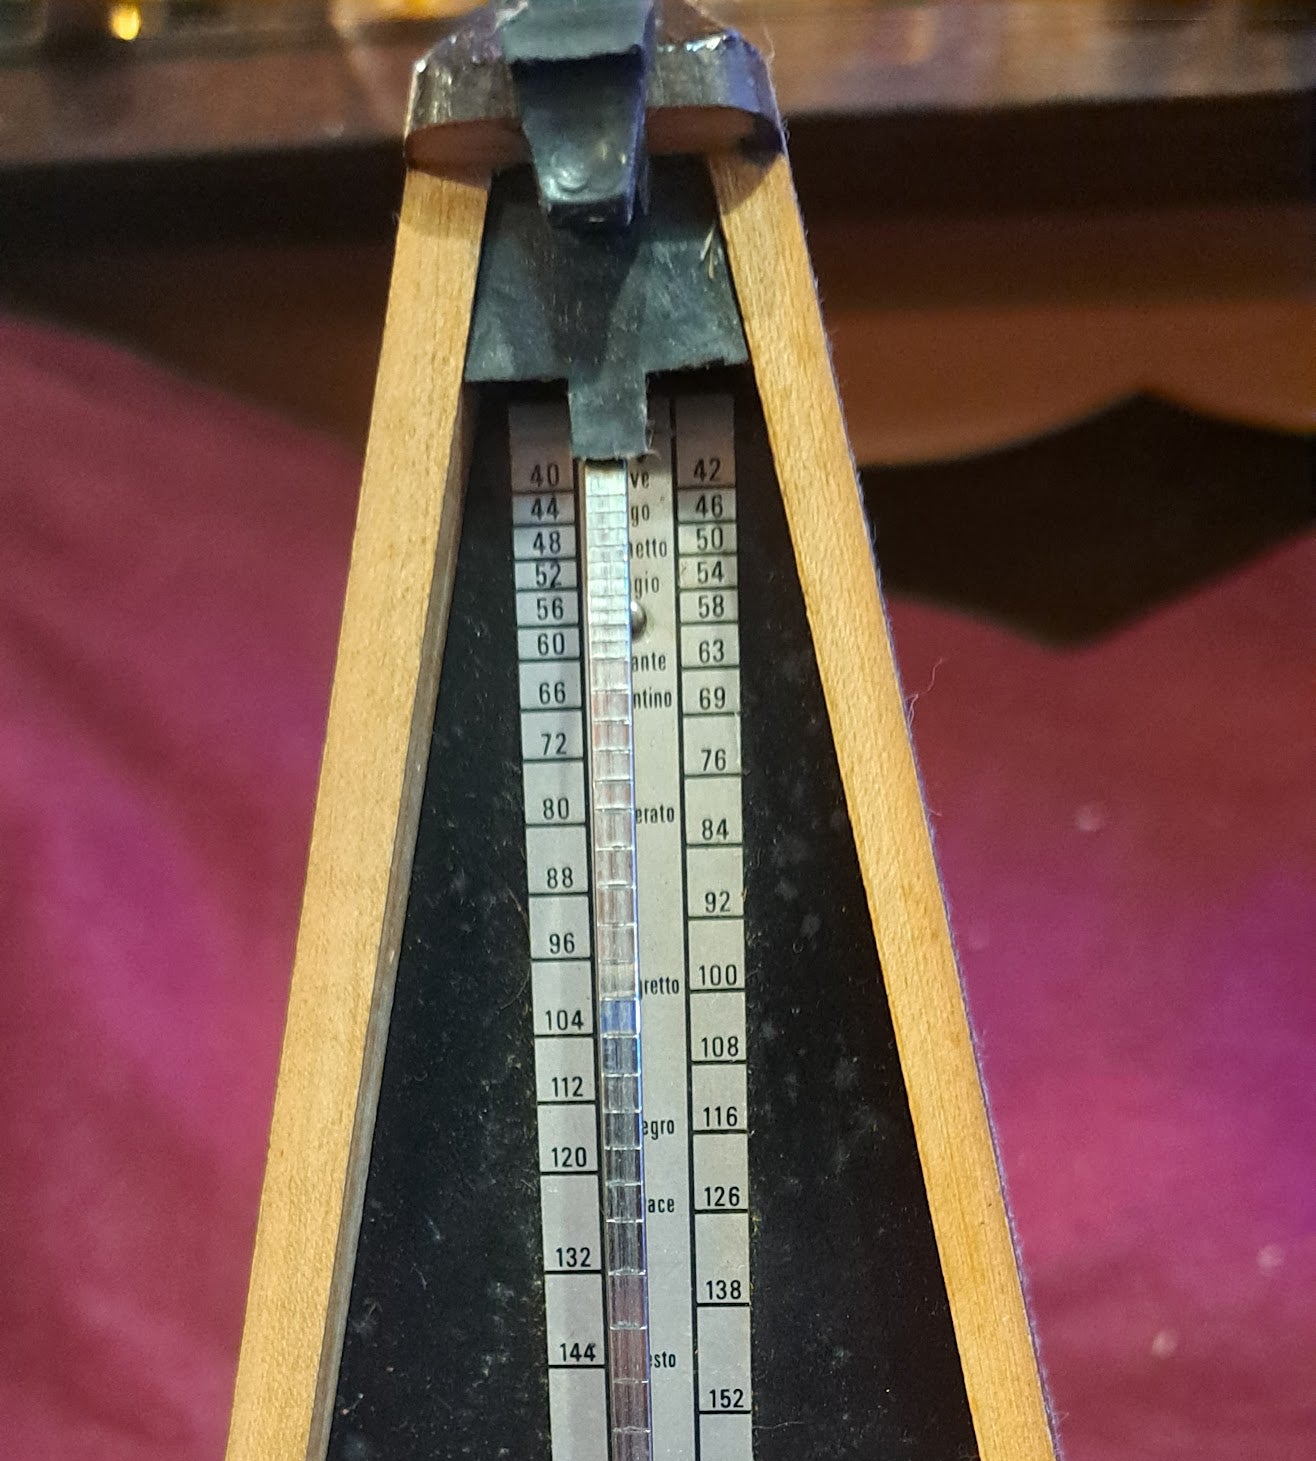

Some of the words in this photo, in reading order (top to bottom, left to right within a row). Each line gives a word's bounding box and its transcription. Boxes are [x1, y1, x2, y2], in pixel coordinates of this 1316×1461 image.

[529, 463, 560, 488] 40
[629, 470, 650, 489] ve
[693, 458, 722, 482] 42
[530, 498, 560, 521] 44
[630, 505, 651, 528] go
[694, 494, 724, 519] 46
[532, 530, 562, 555] 48
[695, 526, 724, 551] 50
[534, 561, 562, 588] 52
[697, 560, 725, 584] 54
[634, 570, 660, 598] gio
[536, 597, 564, 622] 56
[698, 594, 725, 619] 58
[537, 631, 566, 656] 60
[698, 638, 725, 664] 63
[538, 681, 566, 705] 66
[699, 686, 726, 711] 69
[540, 732, 568, 756] 72
[700, 748, 727, 772] 76
[542, 797, 570, 820] 80
[700, 817, 730, 841] 84
[546, 866, 574, 889] 88
[704, 891, 731, 914] 92
[548, 932, 576, 955] 96
[698, 964, 738, 987] 100
[545, 1009, 585, 1031] 104
[700, 1035, 739, 1058] 108
[551, 1076, 584, 1098] 112
[702, 1105, 738, 1128] 116
[550, 1146, 588, 1168] 120
[647, 1196, 676, 1214] ace
[703, 1185, 741, 1208] 126
[555, 1247, 592, 1268] 132
[705, 1279, 742, 1300] 138
[559, 1342, 597, 1363] 144
[708, 1388, 744, 1409] 152
